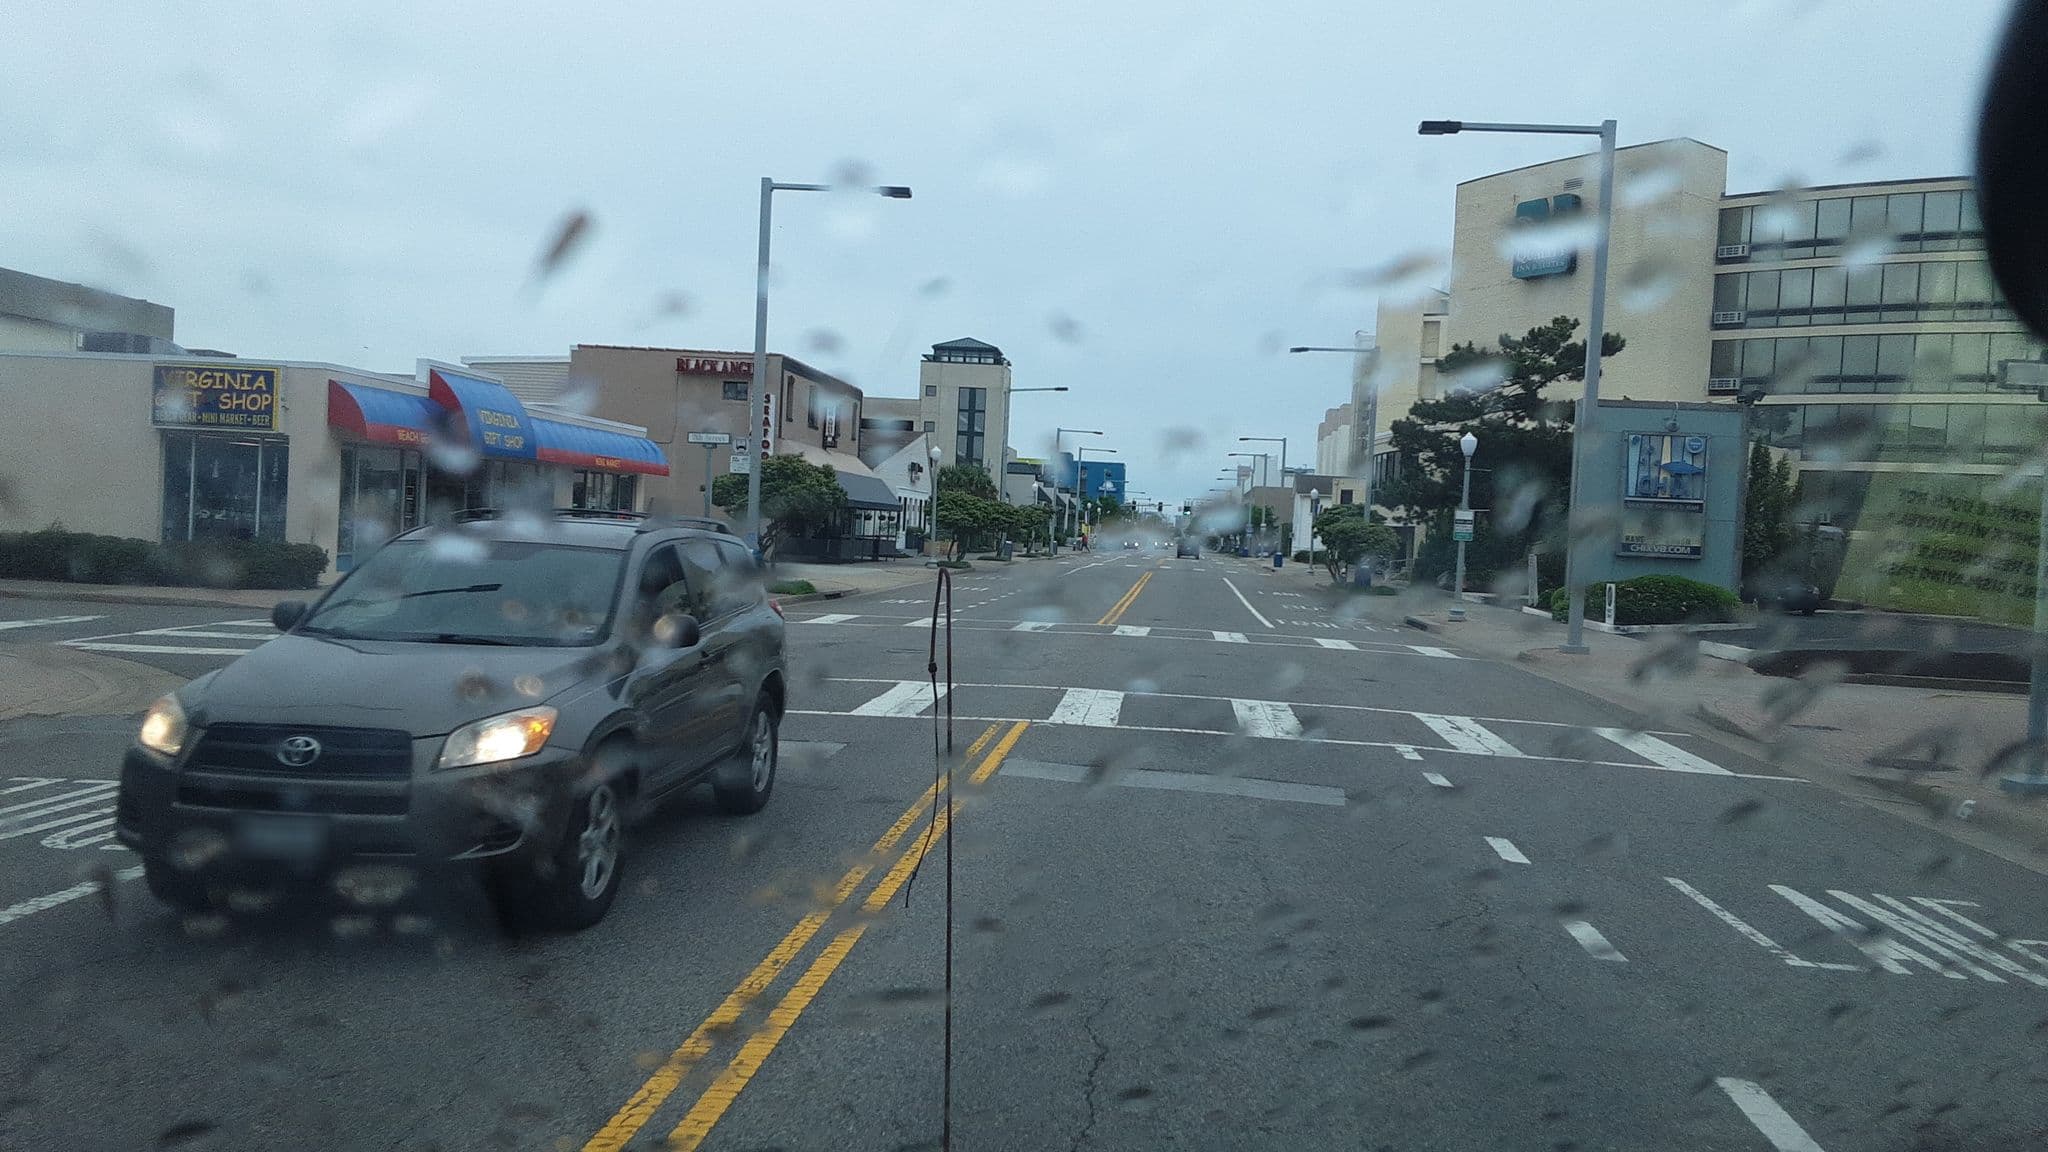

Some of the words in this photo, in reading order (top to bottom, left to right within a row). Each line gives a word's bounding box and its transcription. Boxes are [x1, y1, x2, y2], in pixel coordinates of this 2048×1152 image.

[676, 358, 718, 373] BLACK
[219, 393, 272, 410] SHOP
[219, 413, 247, 425] MARKET
[252, 414, 270, 426] BEER
[760, 393, 771, 460] SEAFOO
[503, 435, 524, 449] SHOP
